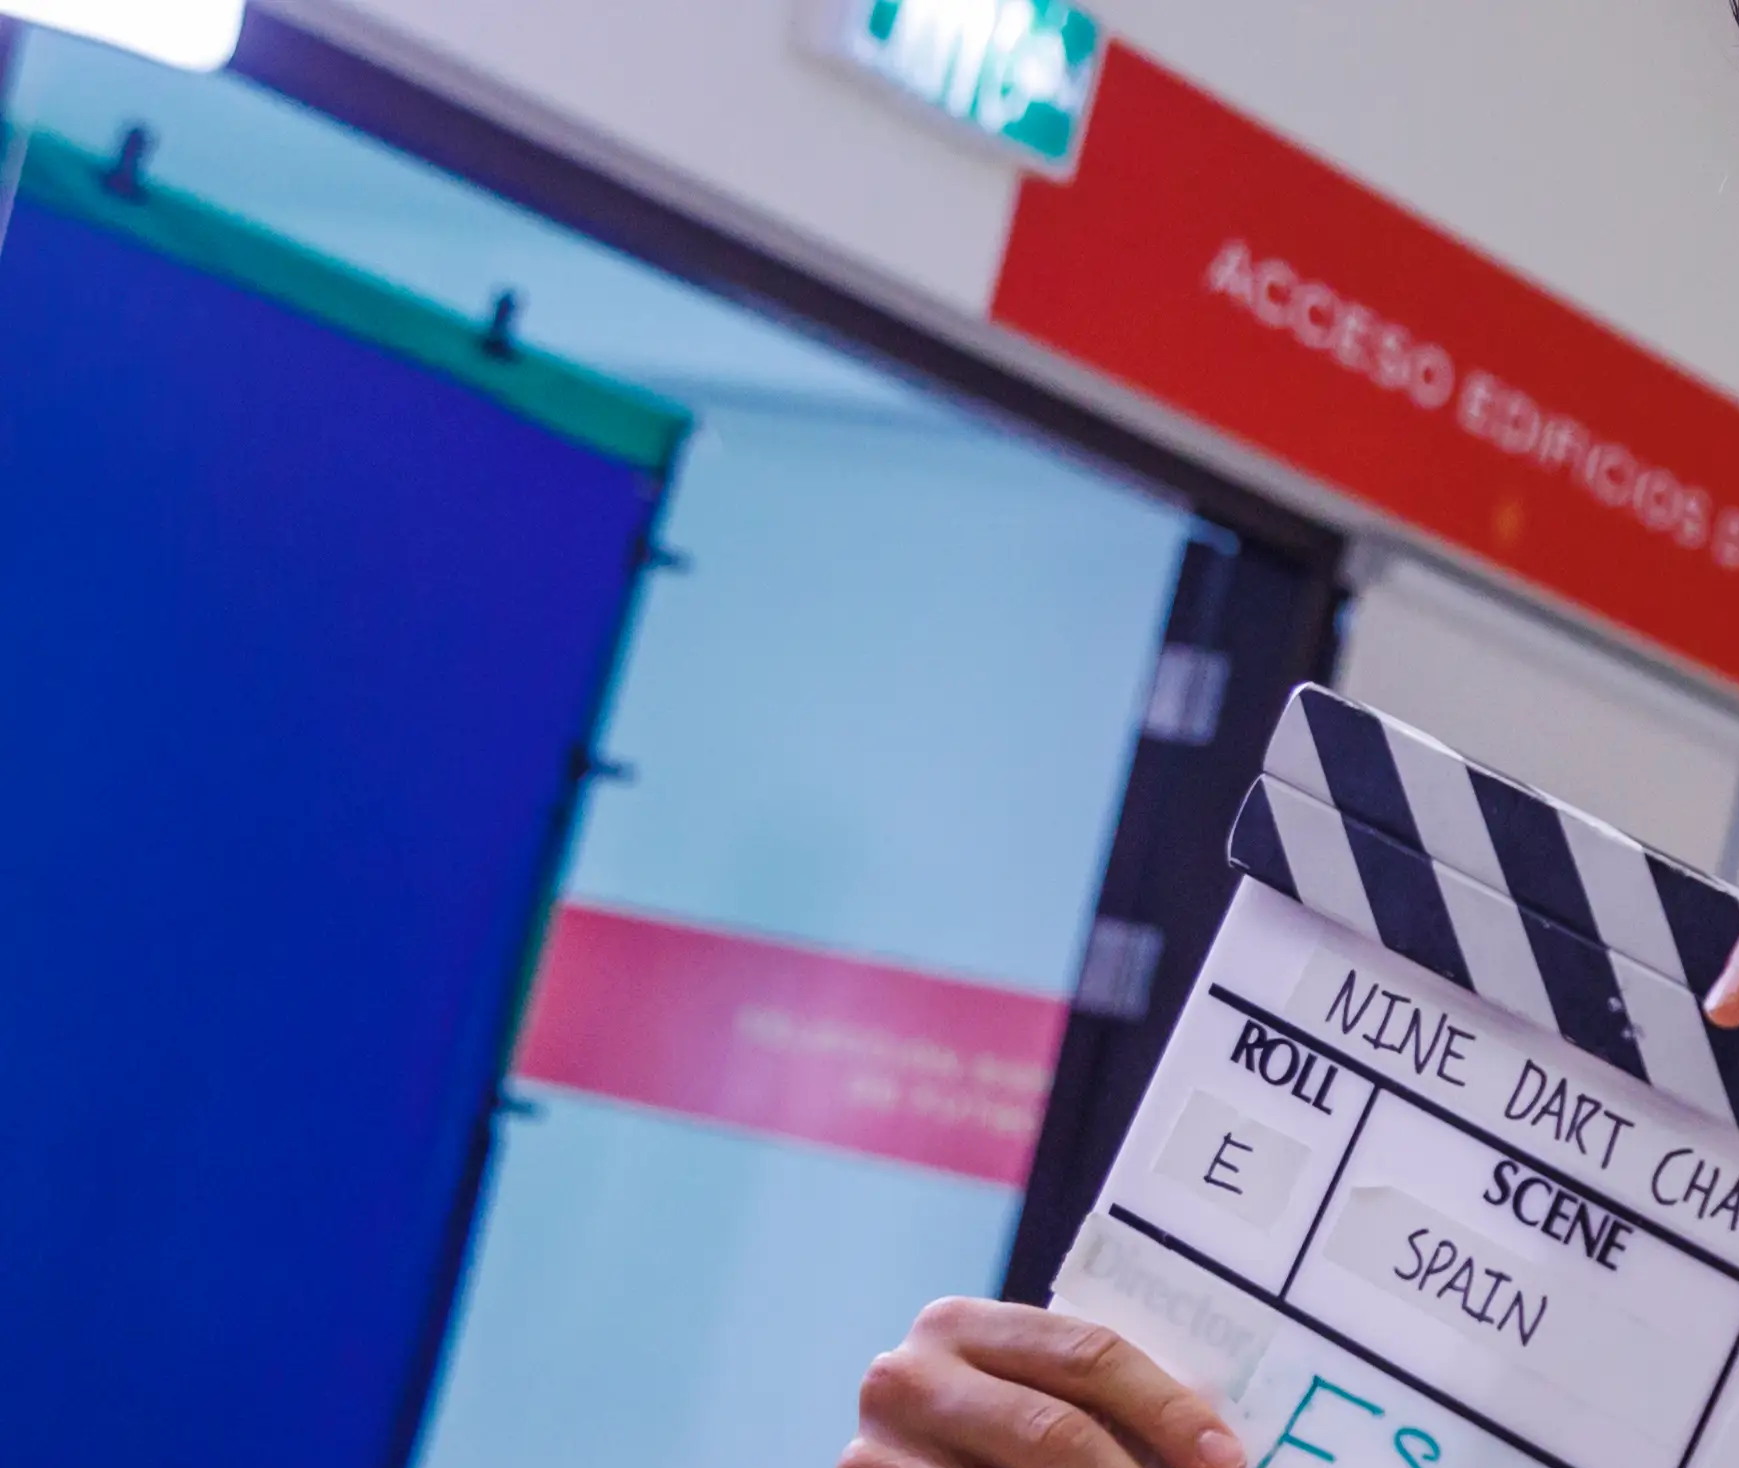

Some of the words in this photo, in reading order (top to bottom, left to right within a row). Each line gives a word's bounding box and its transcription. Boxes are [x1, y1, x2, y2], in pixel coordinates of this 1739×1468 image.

[1207, 242, 1455, 408] ACCESO
[1231, 1020, 1338, 1115] ROLL
[1325, 969, 1476, 1087] NINE
[1504, 1059, 1635, 1170] DART
[1203, 1132, 1254, 1194] E
[1483, 1160, 1634, 1272] SCENE
[1394, 1228, 1548, 1347] SPAIN
